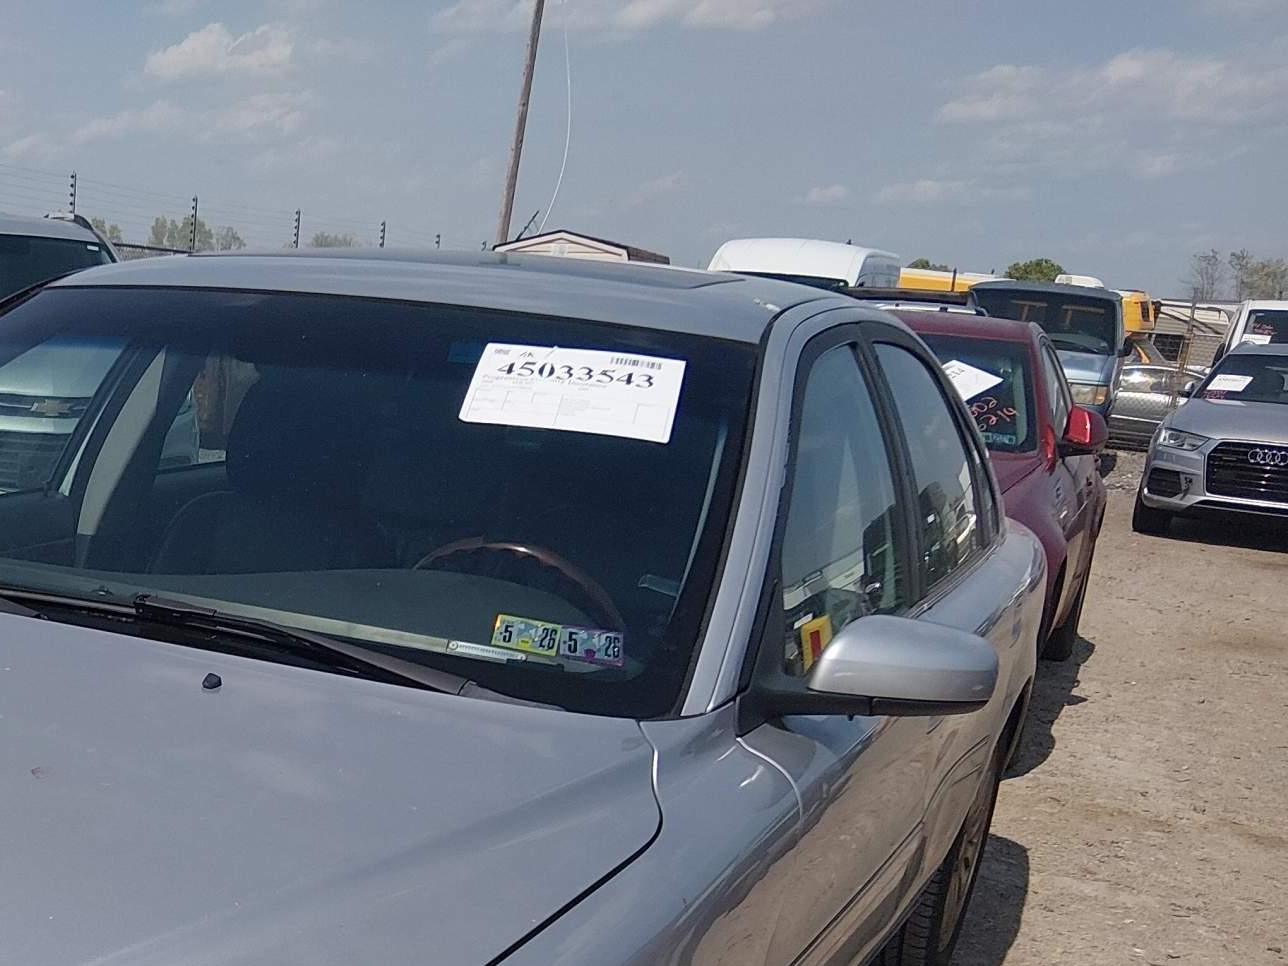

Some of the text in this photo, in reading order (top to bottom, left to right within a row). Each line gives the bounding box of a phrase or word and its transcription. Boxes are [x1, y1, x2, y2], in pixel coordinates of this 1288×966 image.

[497, 361, 654, 389] 45033543
[502, 624, 558, 650] 5 26
[567, 631, 578, 654] 5
